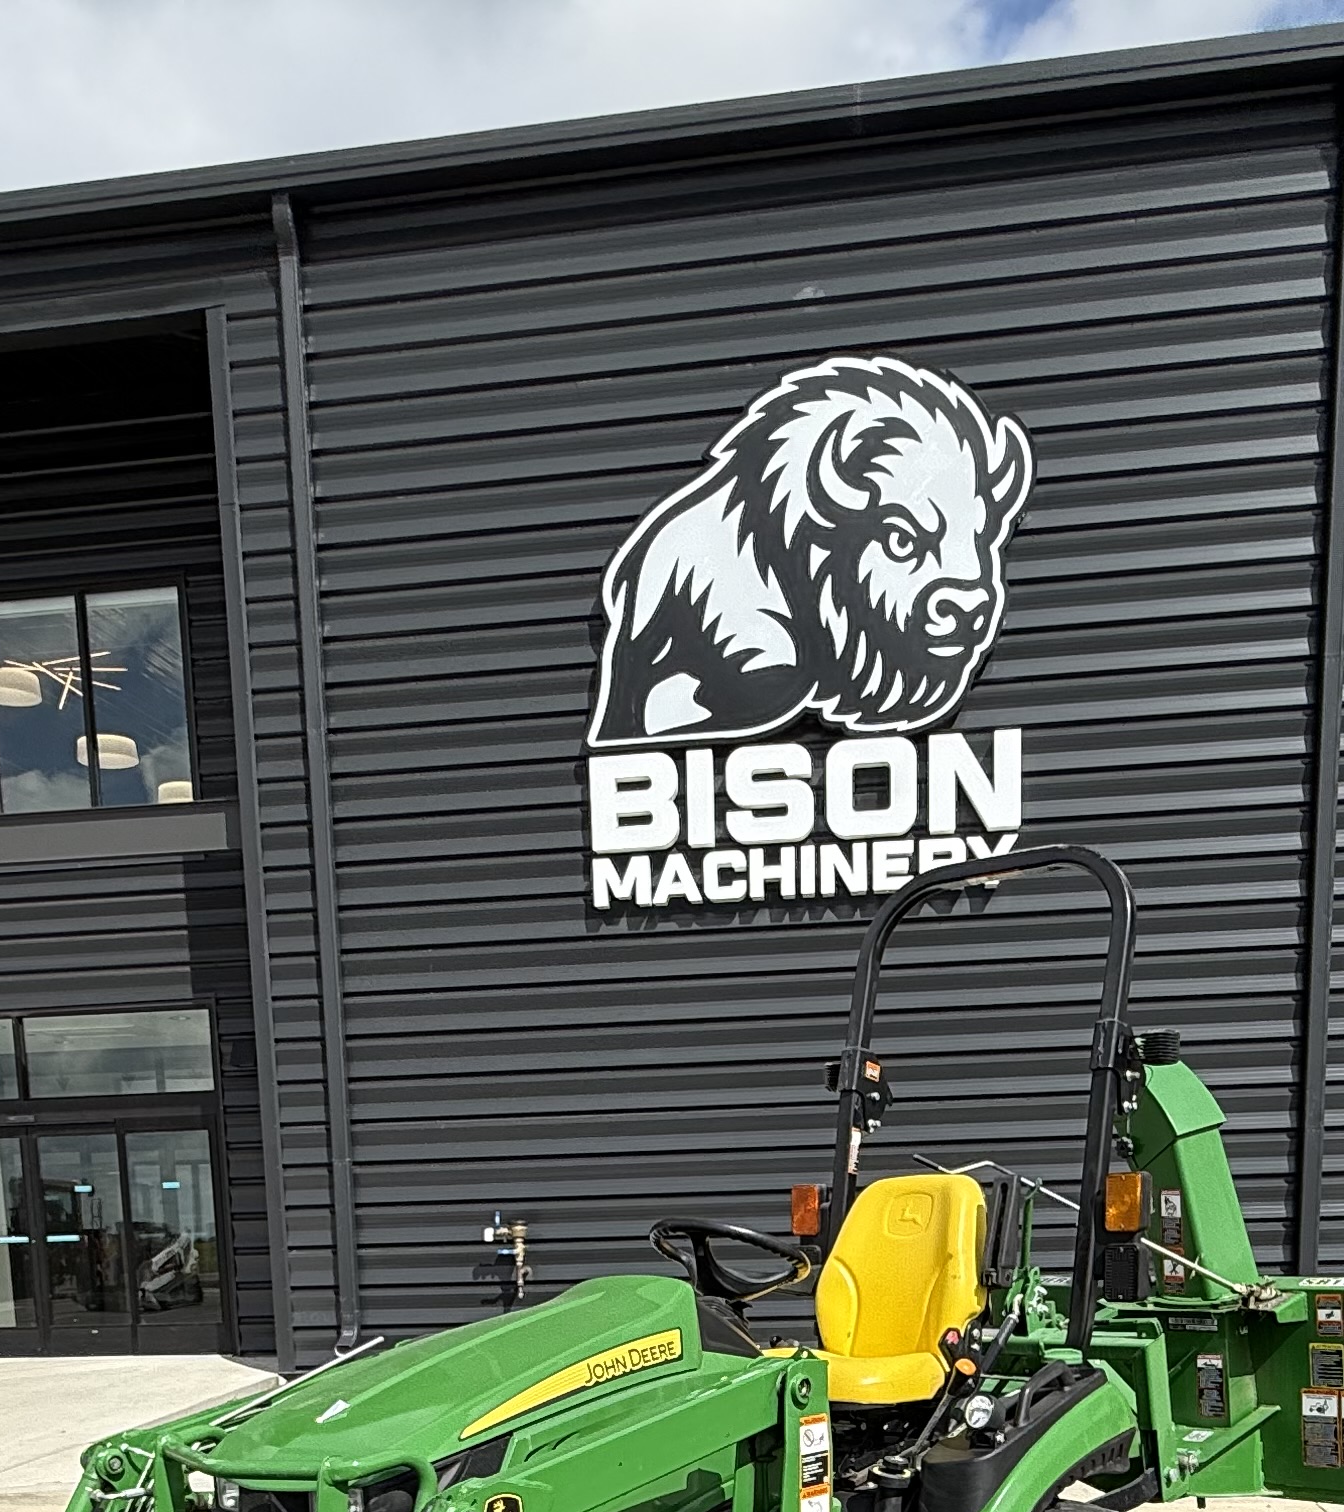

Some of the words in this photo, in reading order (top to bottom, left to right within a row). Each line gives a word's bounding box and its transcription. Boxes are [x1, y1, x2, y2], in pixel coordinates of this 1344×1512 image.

[588, 728, 1022, 853] BISON
[585, 1355, 628, 1384] JOHN
[628, 1341, 676, 1367] DEERE
